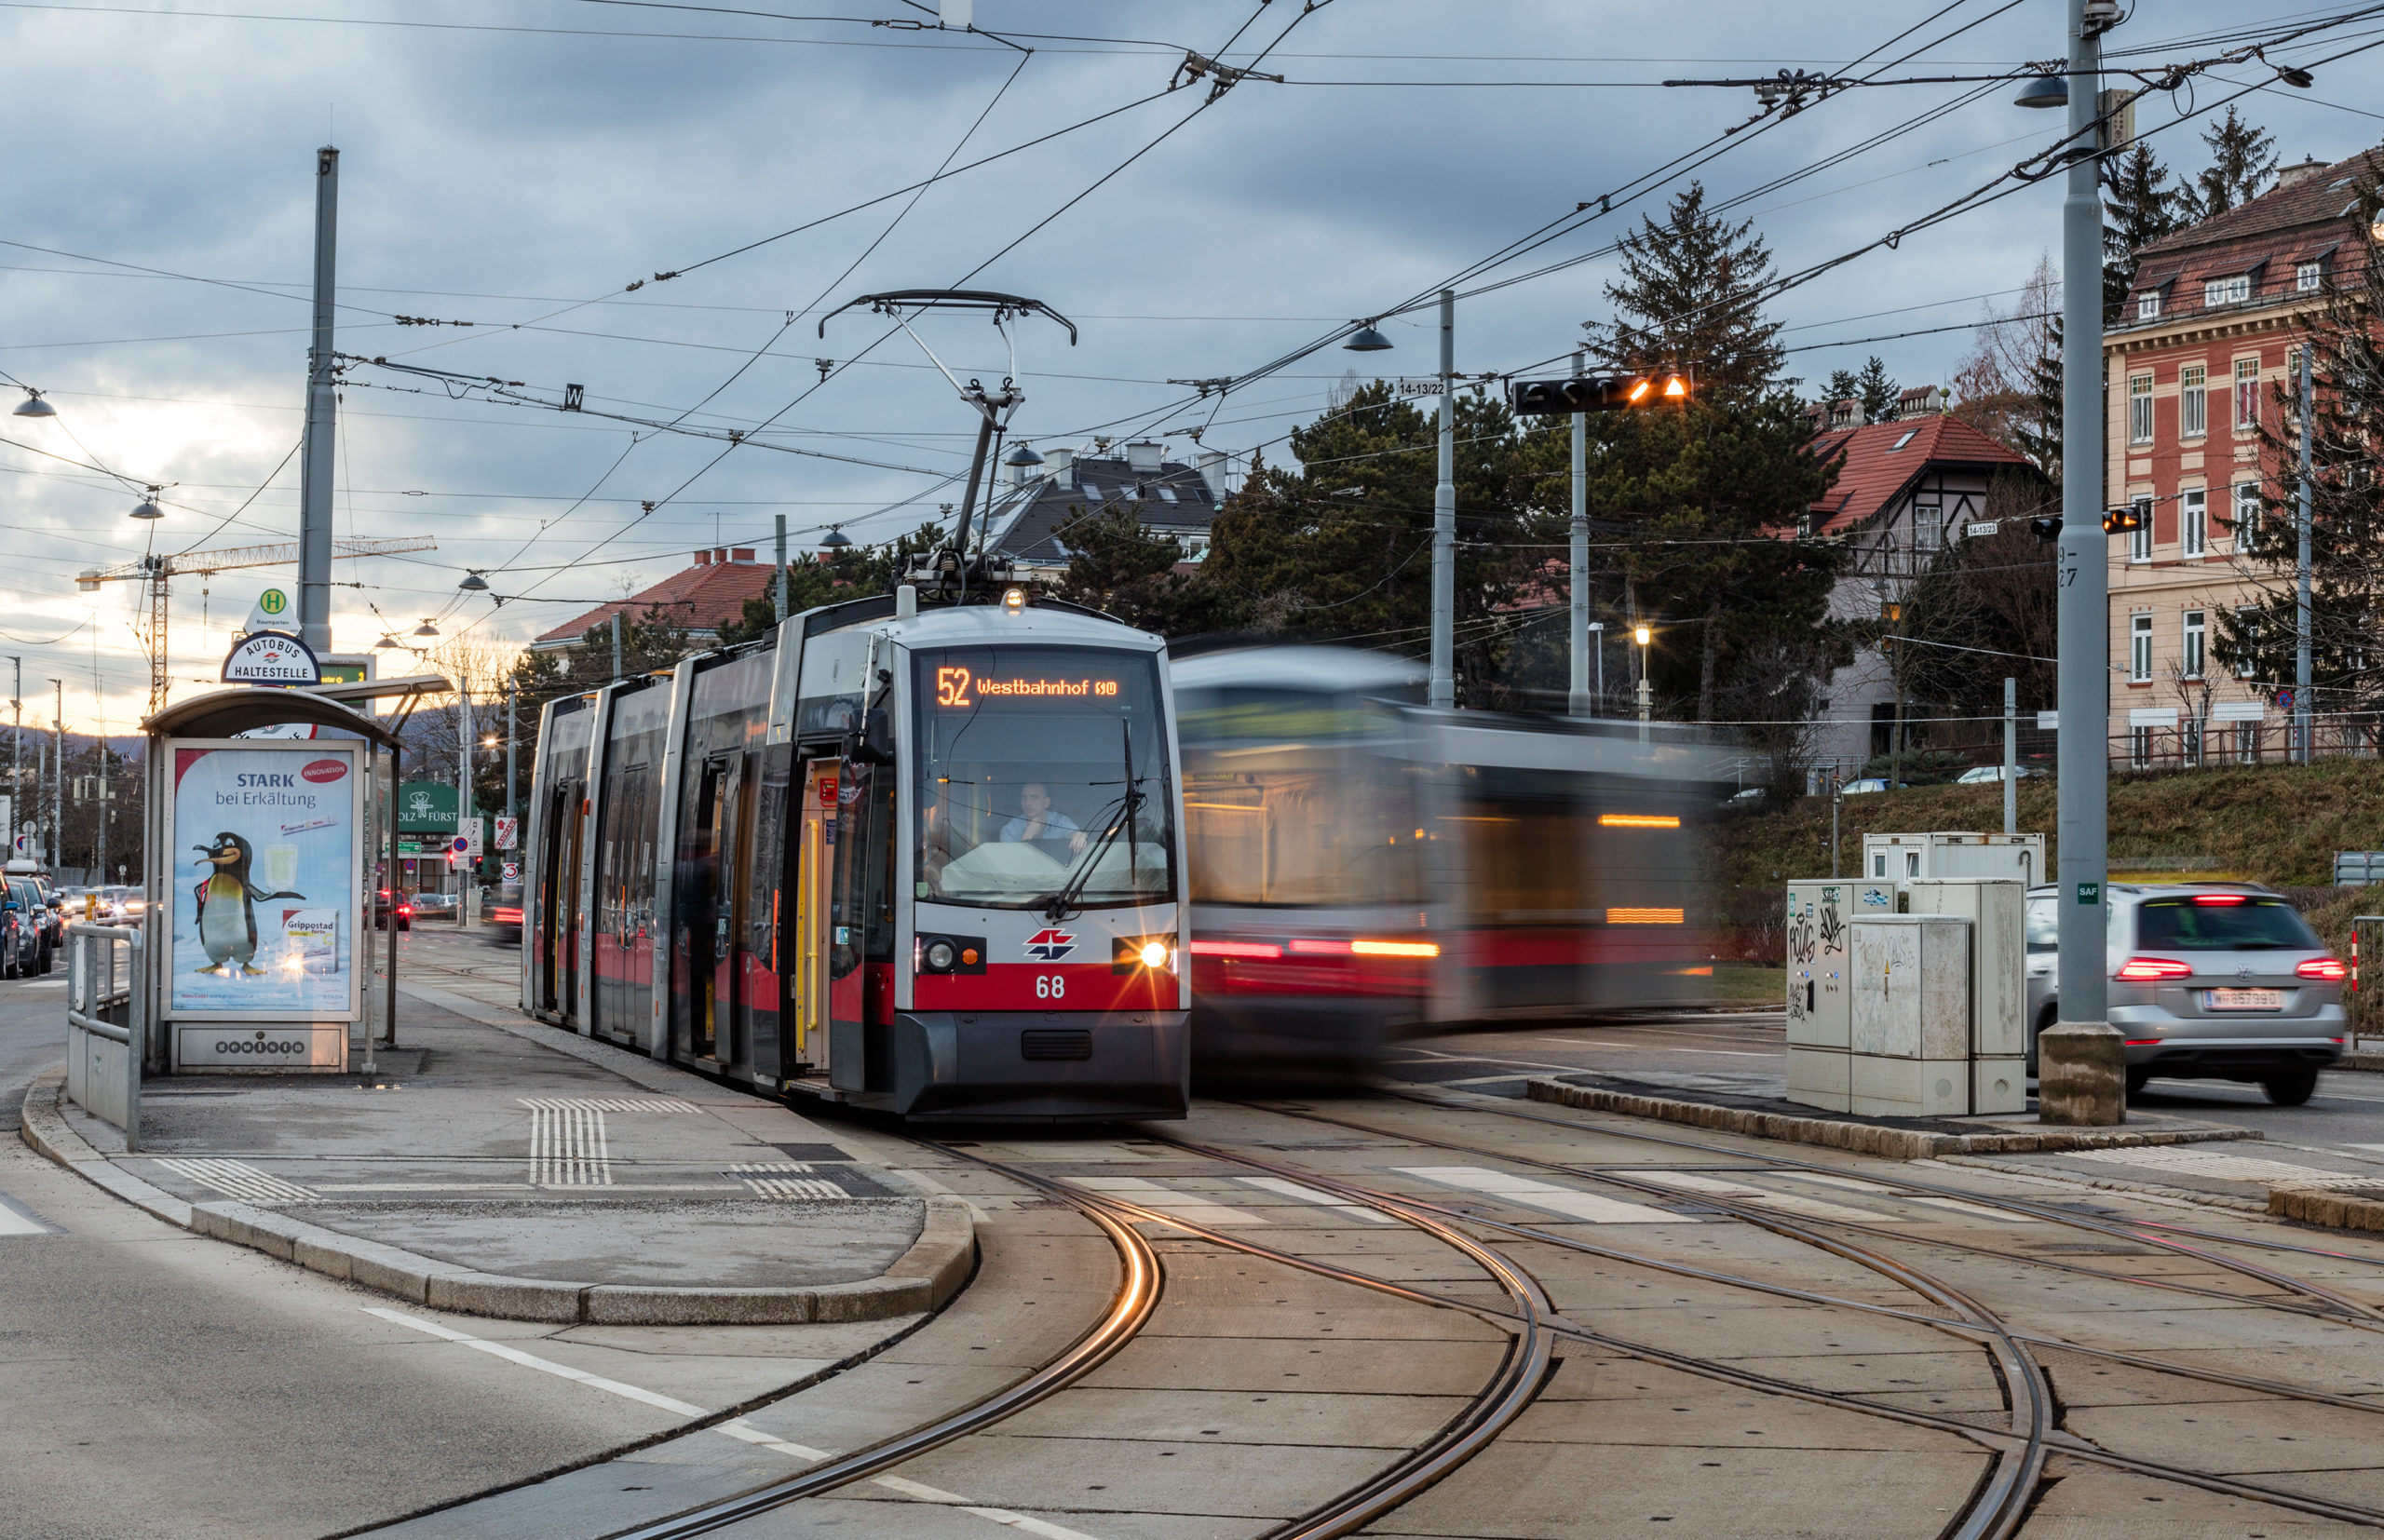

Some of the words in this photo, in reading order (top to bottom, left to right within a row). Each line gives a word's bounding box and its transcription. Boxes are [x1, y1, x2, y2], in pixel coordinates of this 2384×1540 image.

[1400, 384, 1444, 395] 14-13/22
[1970, 525, 1997, 535] 14-13/23
[246, 639, 300, 658] AUTOBUS
[235, 666, 308, 679] HALTESTELLE
[938, 669, 970, 706] 52
[977, 679, 1090, 696] Westbahnhof
[304, 765, 345, 777] INNOVATION
[237, 773, 294, 788] STARK
[215, 791, 238, 805] bei
[243, 791, 316, 810] Erkältung
[399, 812, 416, 822] OLZ
[428, 810, 458, 822] FÜRST
[494, 817, 518, 851] BAUHAUS
[2079, 887, 2097, 896] SAF
[288, 921, 333, 931] Grippostad
[1036, 975, 1064, 999] 68
